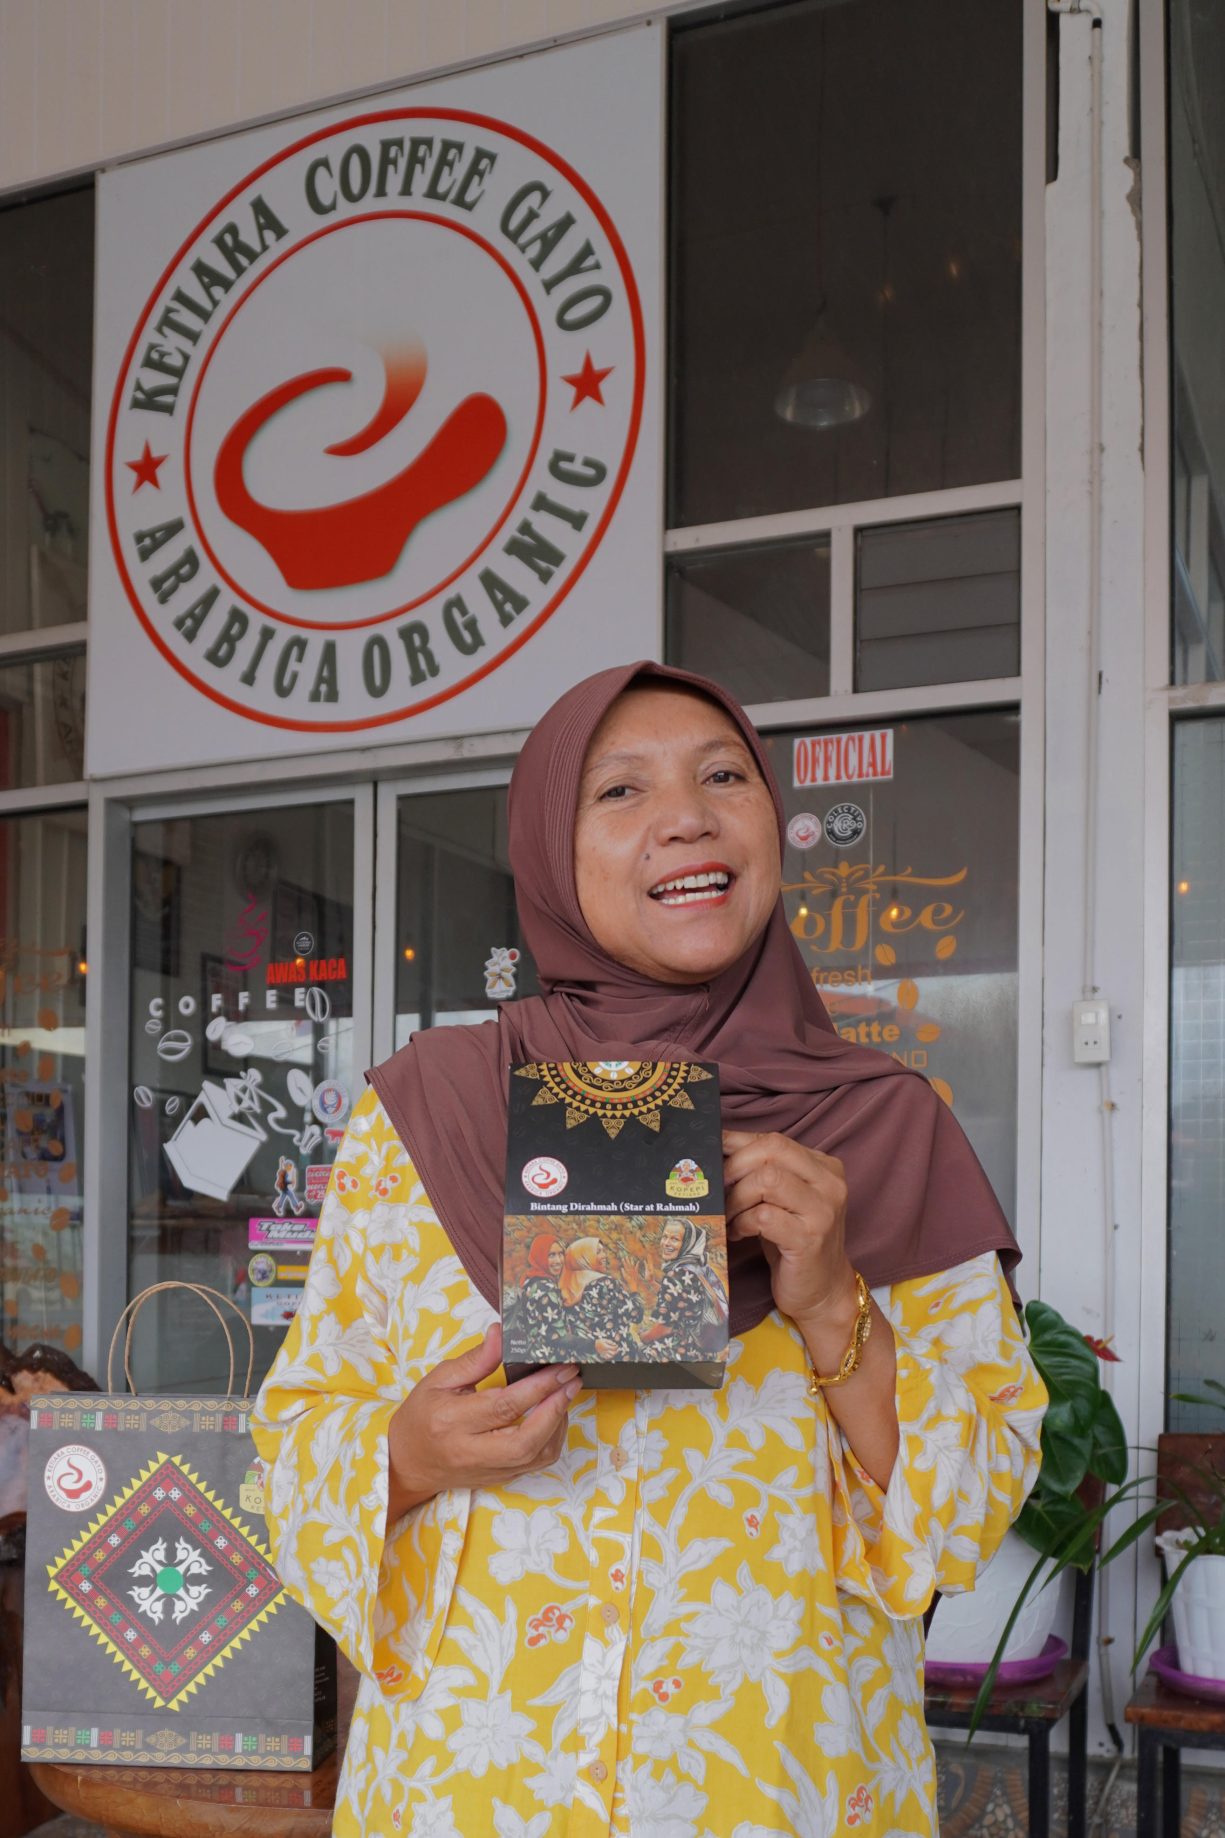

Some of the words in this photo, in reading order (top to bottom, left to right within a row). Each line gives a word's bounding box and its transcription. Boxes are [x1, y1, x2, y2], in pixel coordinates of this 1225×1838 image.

[129, 194, 289, 417] KETIARA
[303, 136, 498, 218] COFFEE
[499, 179, 613, 332] GAYO
[133, 517, 339, 703] ARABICA
[362, 448, 608, 699] ORGANIC
[796, 731, 892, 785] OFFICIAL
[826, 805, 864, 829] COLECTIVO
[790, 892, 965, 953] offee
[265, 960, 307, 985] AWAS
[309, 957, 347, 982] KACA
[149, 987, 306, 1018] COFFEE
[530, 1202, 568, 1213] Bintang
[569, 1202, 618, 1212] Dirahmah
[619, 1202, 644, 1213] (Star
[645, 1203, 655, 1212] at
[656, 1202, 700, 1213] Rahmah)
